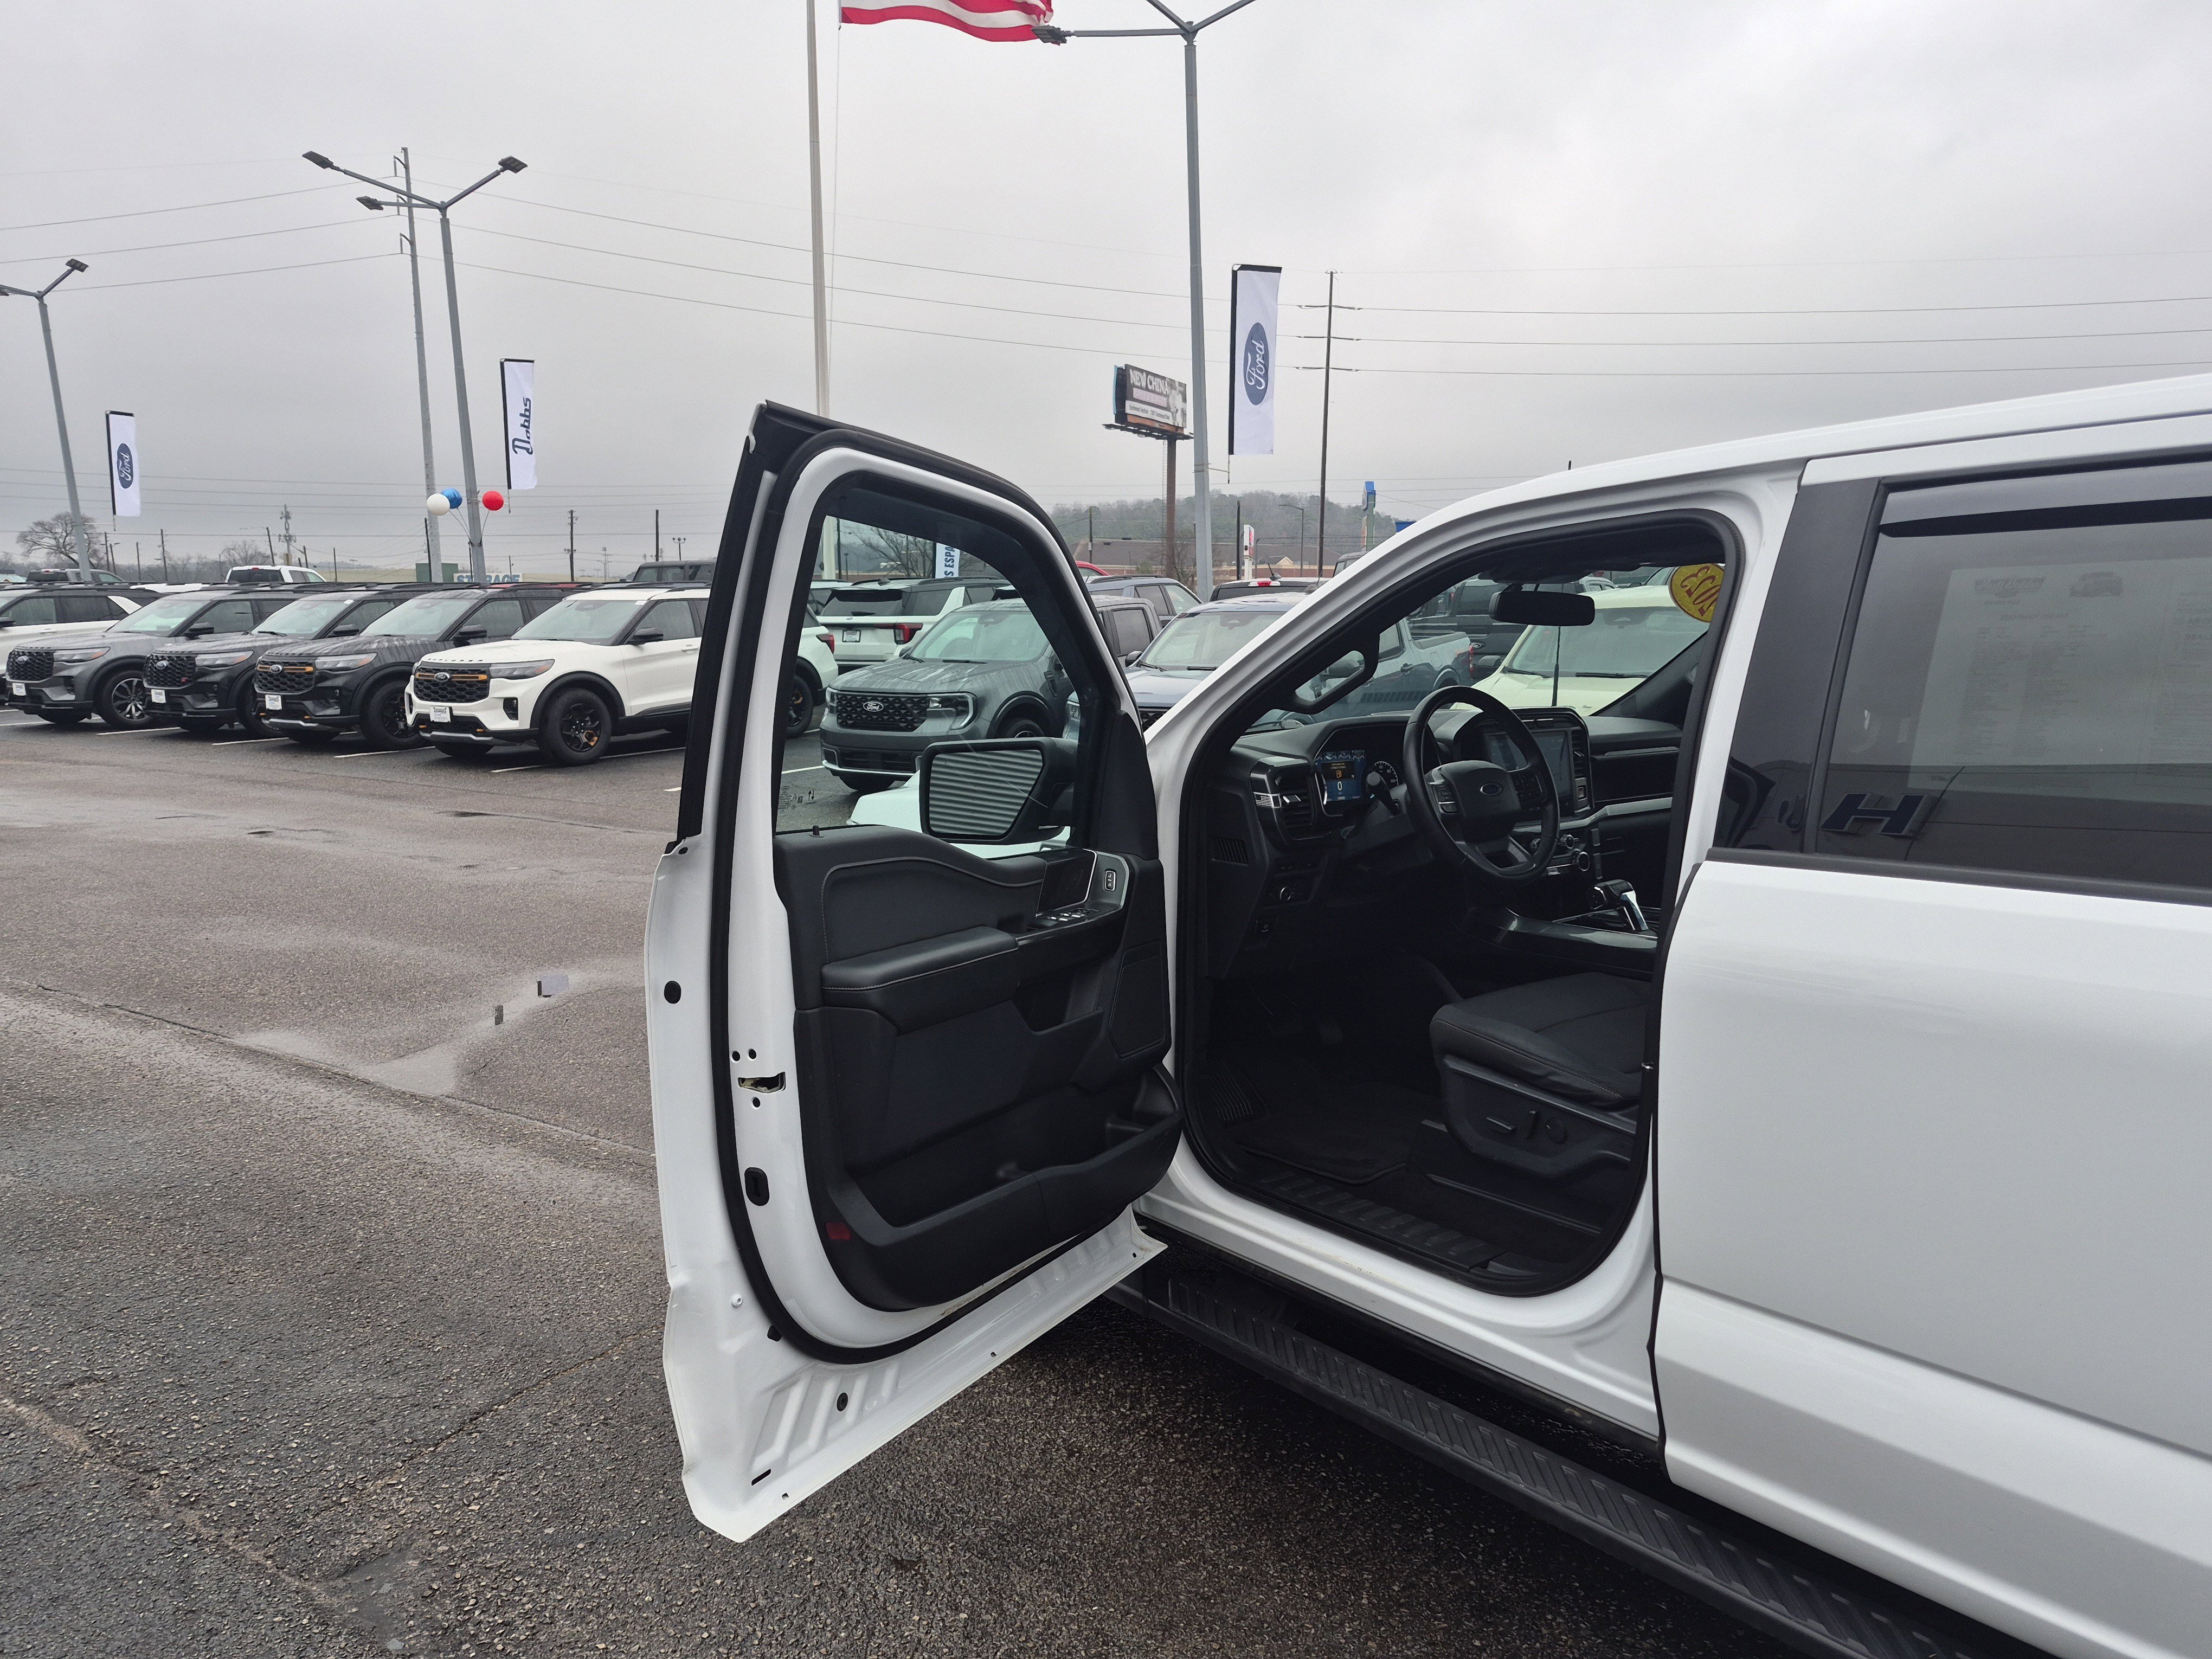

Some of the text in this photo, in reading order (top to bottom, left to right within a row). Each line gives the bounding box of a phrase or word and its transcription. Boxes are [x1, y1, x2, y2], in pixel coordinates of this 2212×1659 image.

[1246, 339, 1266, 390] Ford
[1129, 368, 1169, 395] NEW CHINA
[512, 397, 533, 455] Dobbs
[119, 452, 132, 481] Ford
[456, 574, 520, 583] STRAGE
